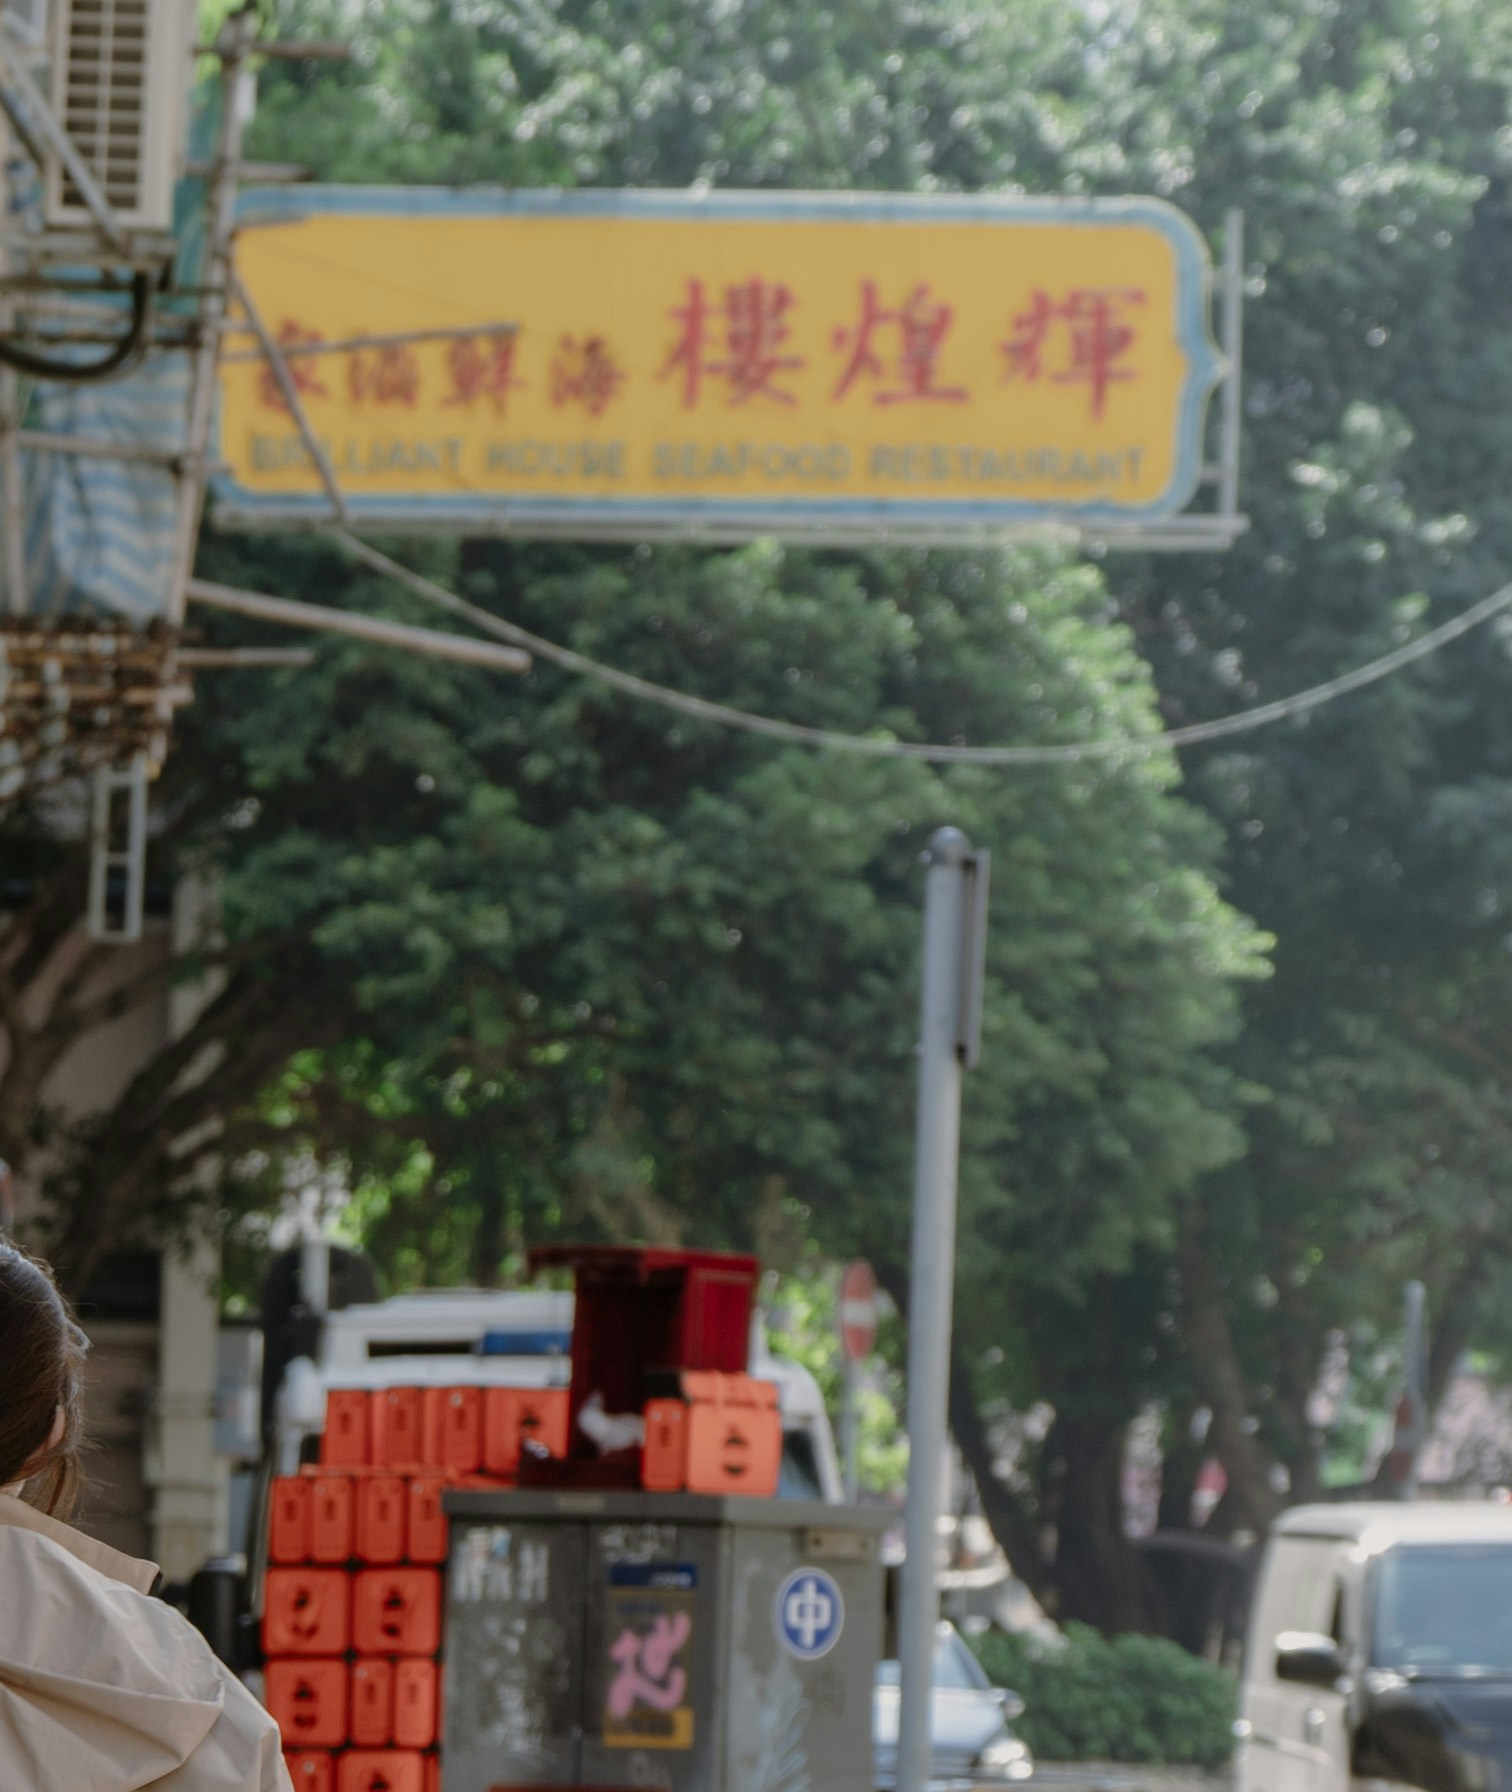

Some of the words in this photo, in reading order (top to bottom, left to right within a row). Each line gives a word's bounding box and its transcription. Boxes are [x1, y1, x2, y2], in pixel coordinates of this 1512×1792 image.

[251, 435, 464, 474] BRLLIANT
[487, 438, 626, 477] HOUSE
[654, 442, 853, 480] SEAFOOD
[870, 446, 1147, 485] RESTAURANT
